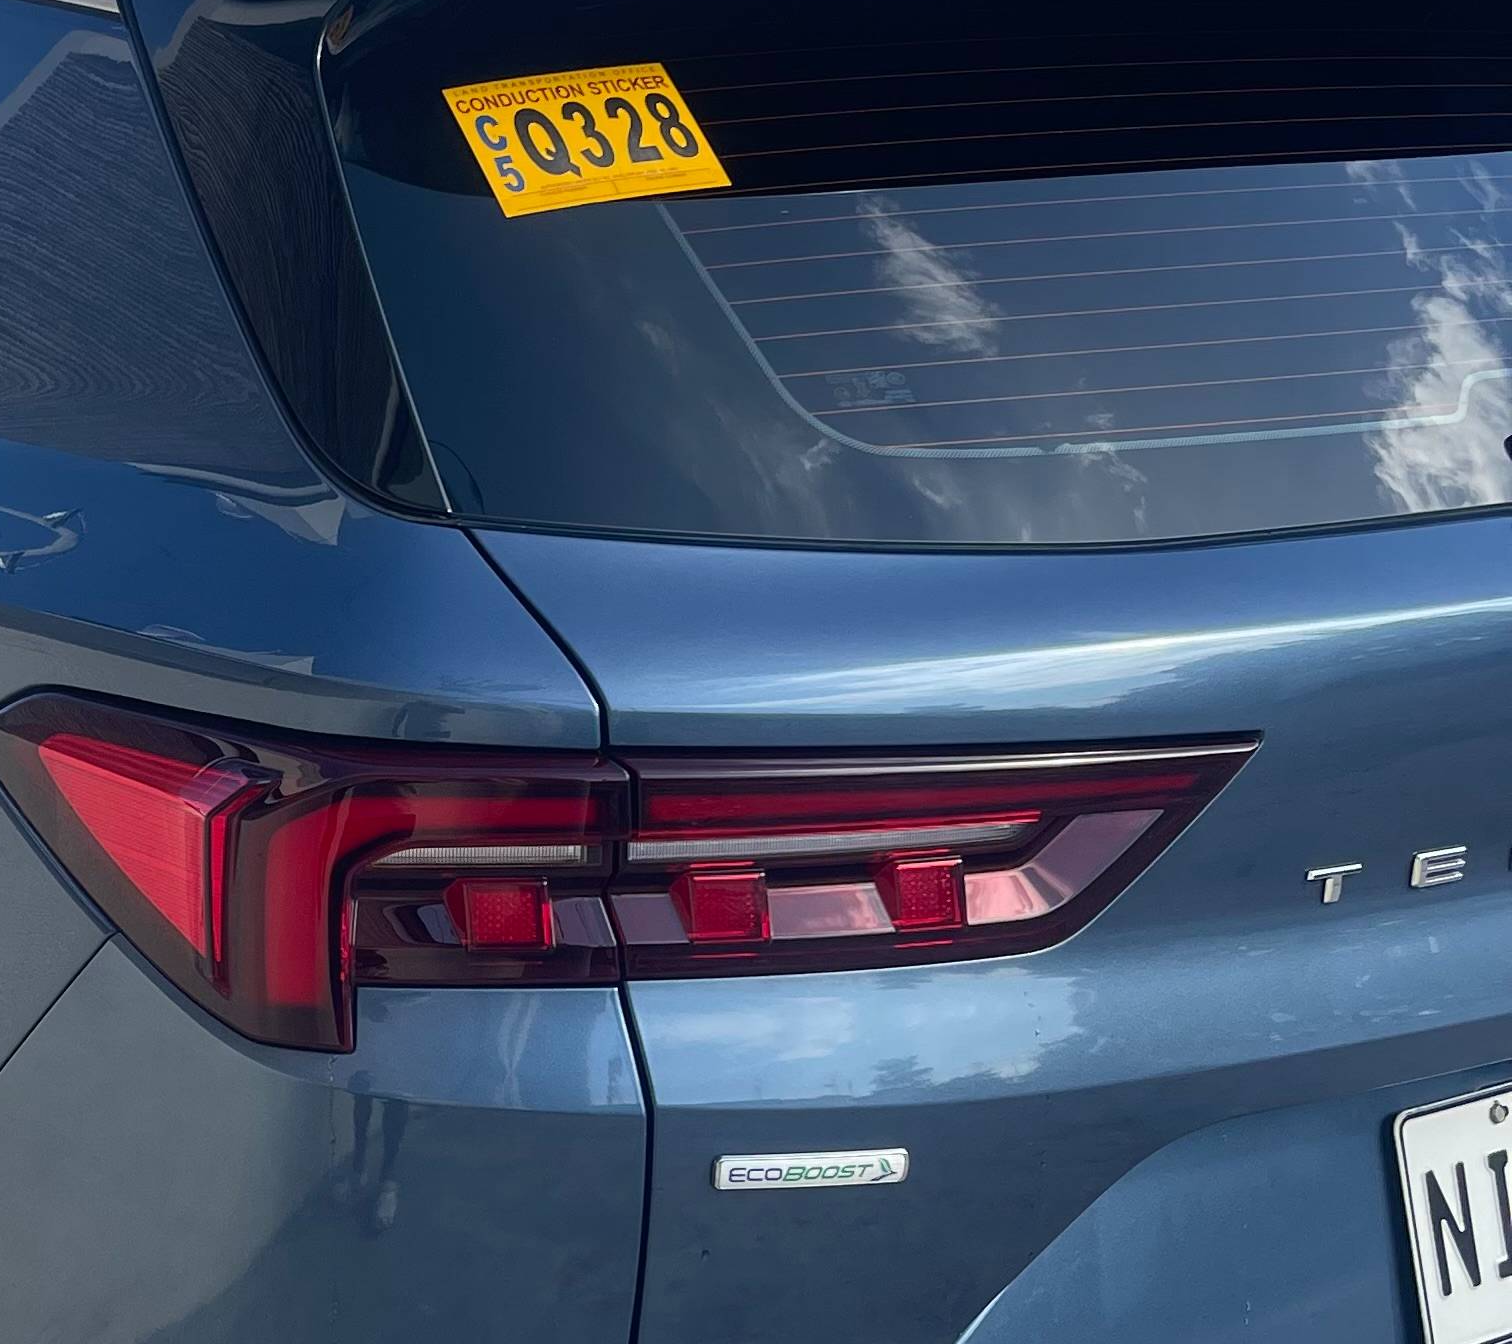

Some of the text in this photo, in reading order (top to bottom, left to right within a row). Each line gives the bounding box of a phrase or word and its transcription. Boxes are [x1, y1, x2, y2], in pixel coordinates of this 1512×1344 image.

[455, 75, 669, 114] CONDUCTION STICKER
[513, 93, 699, 178] Q328
[728, 1163, 874, 1183] ECOBOOST
